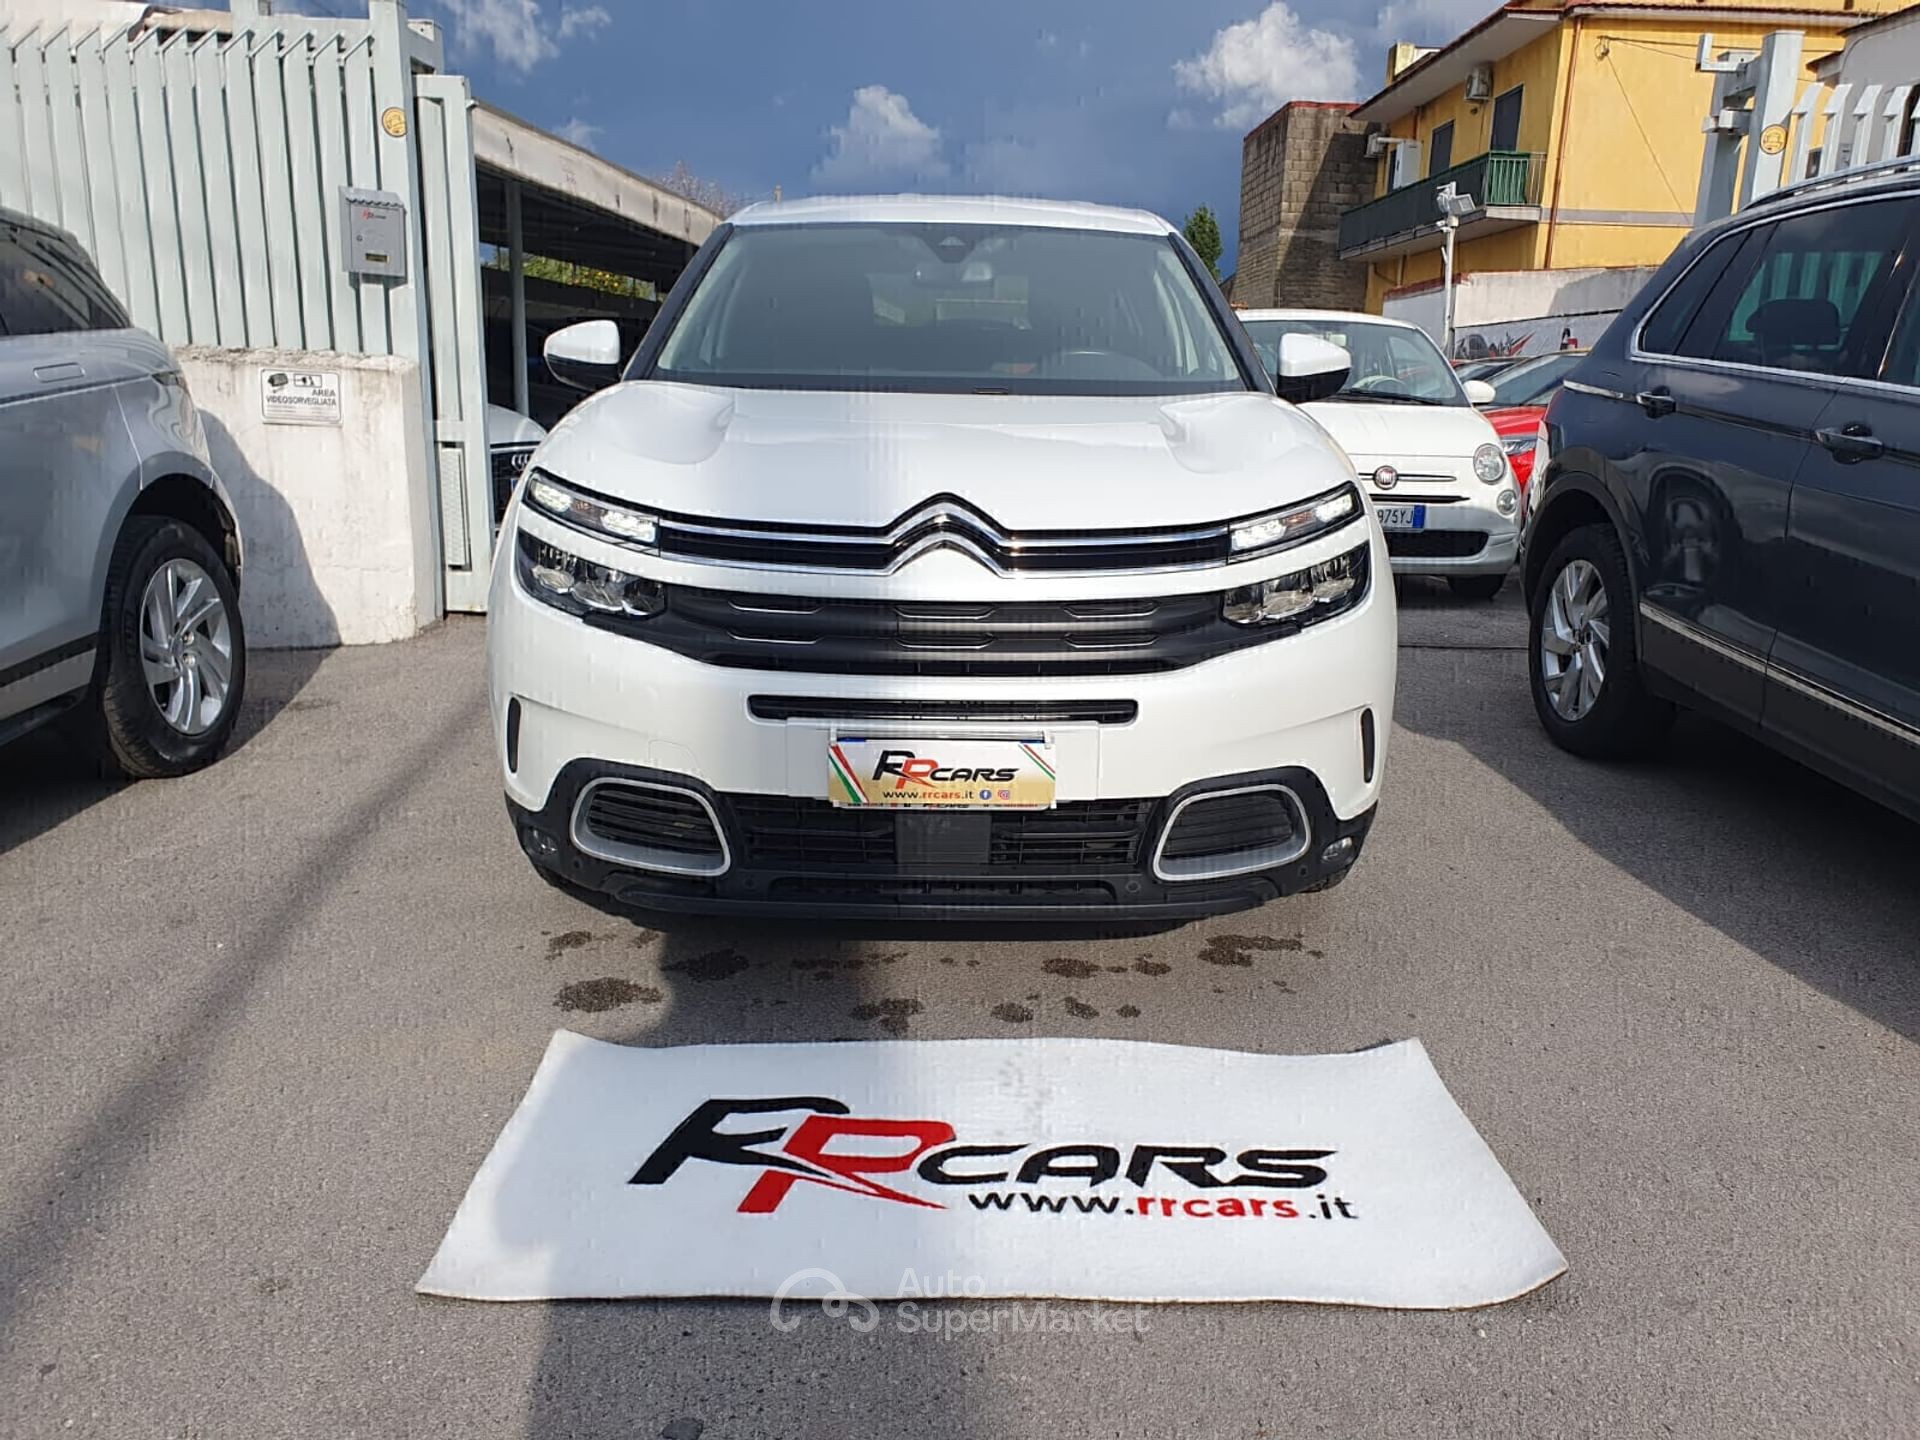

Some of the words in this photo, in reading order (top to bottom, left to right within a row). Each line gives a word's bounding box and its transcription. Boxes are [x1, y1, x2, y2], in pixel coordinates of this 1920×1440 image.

[312, 389, 336, 397] AREA
[882, 789, 974, 800] www.rrcars.it
[968, 1190, 1360, 1221] www.rrcars.it
